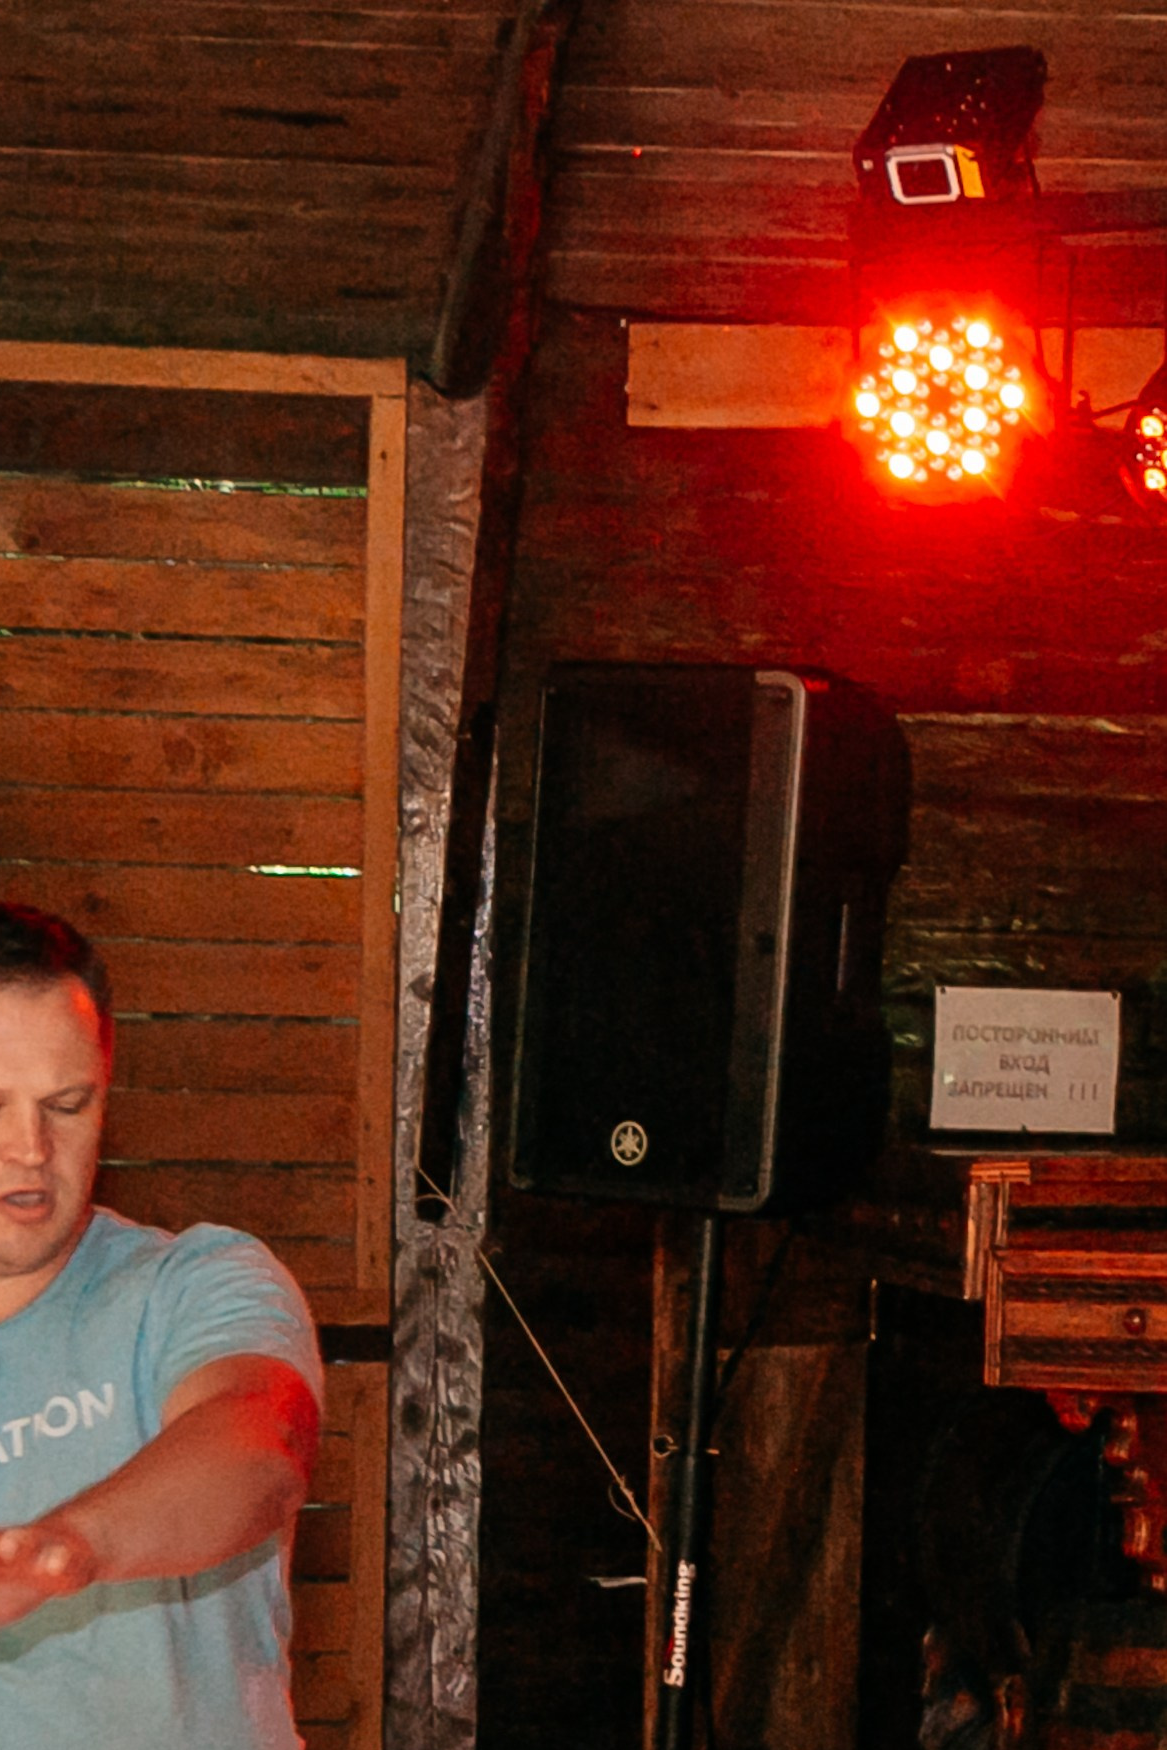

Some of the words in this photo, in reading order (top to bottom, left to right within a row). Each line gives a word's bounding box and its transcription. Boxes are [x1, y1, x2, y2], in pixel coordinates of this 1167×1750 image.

[951, 1024, 1101, 1046] ПОСТОРОННИМ
[999, 1053, 1051, 1075] ВХОД
[947, 1081, 1049, 1101] ЗАПРЕЩЕН
[663, 1559, 697, 1688] Soundking
